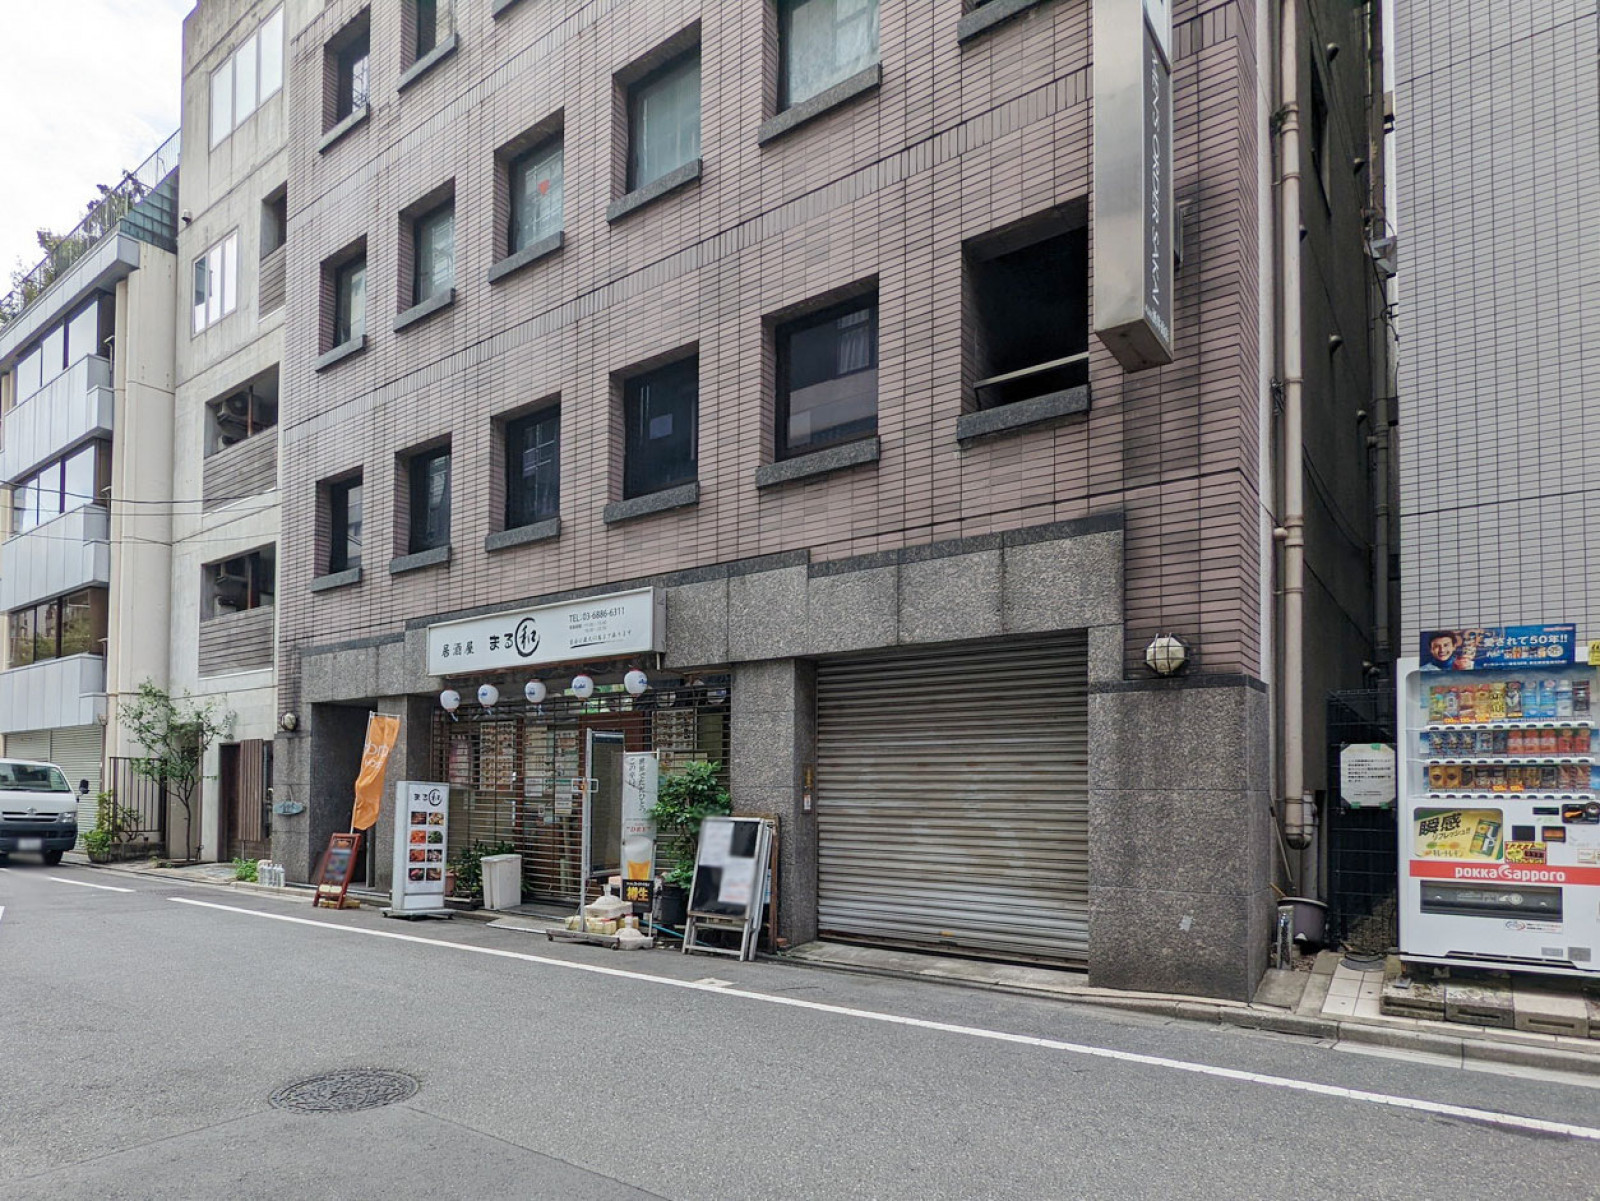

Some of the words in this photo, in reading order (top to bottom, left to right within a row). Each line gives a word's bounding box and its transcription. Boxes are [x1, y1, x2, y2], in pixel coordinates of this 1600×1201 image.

[1151, 134, 1160, 224] ORDER
[1151, 226, 1160, 305] SAKAI
[441, 641, 475, 658] 居酒屋
[1419, 812, 1462, 836] 瞬感
